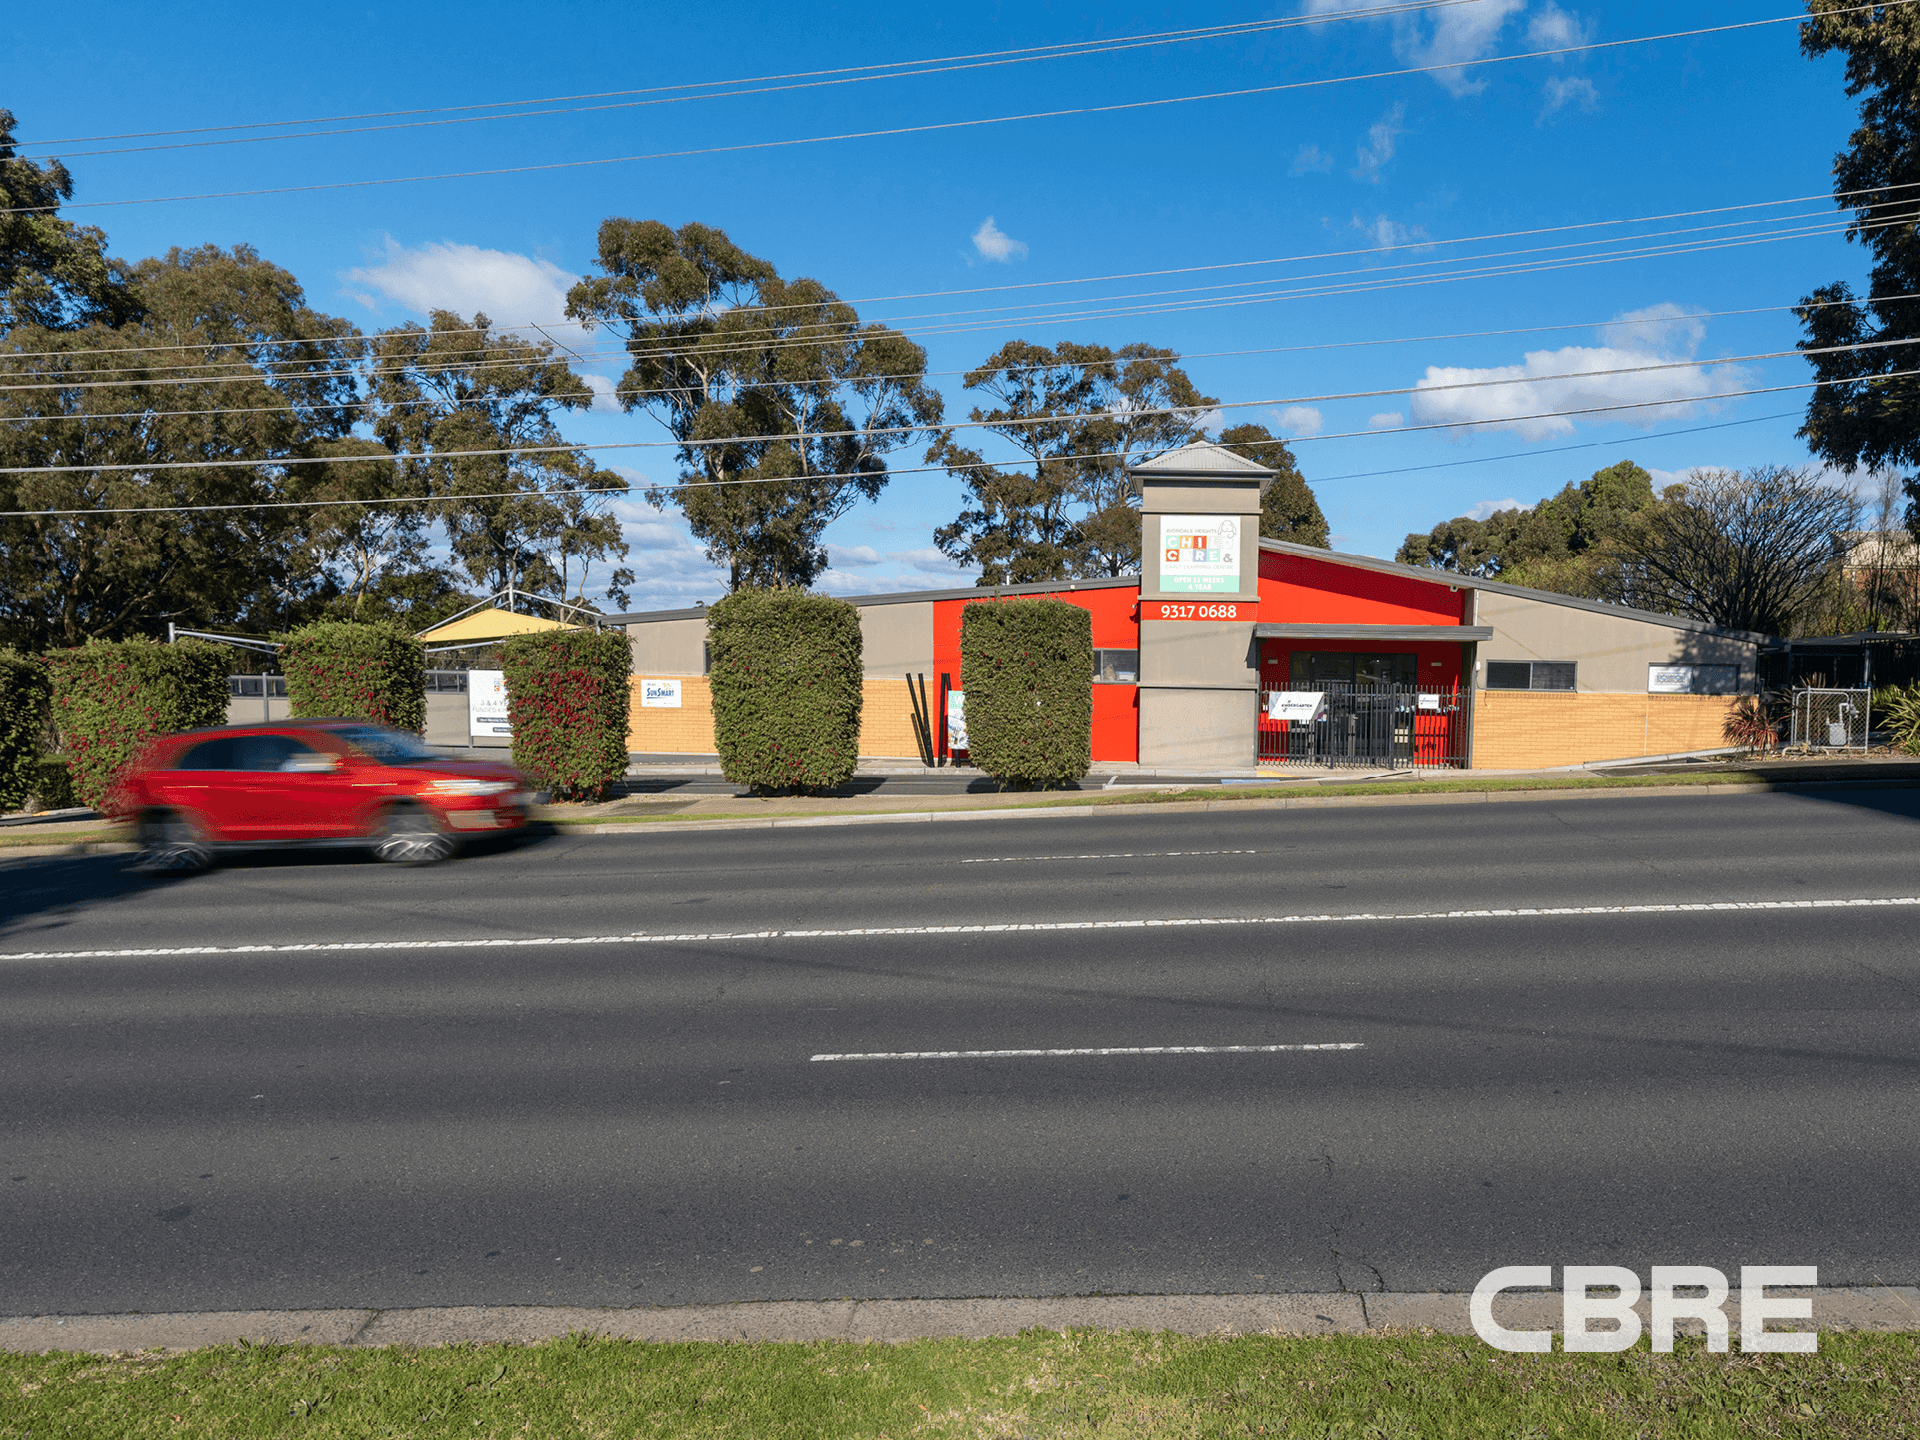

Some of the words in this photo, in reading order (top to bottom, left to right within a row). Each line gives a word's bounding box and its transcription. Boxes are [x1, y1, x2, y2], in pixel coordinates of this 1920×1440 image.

[1166, 549, 1220, 562] CRE
[1223, 553, 1233, 564] &
[1161, 605, 1196, 619] 9317
[1199, 605, 1237, 618] 0688
